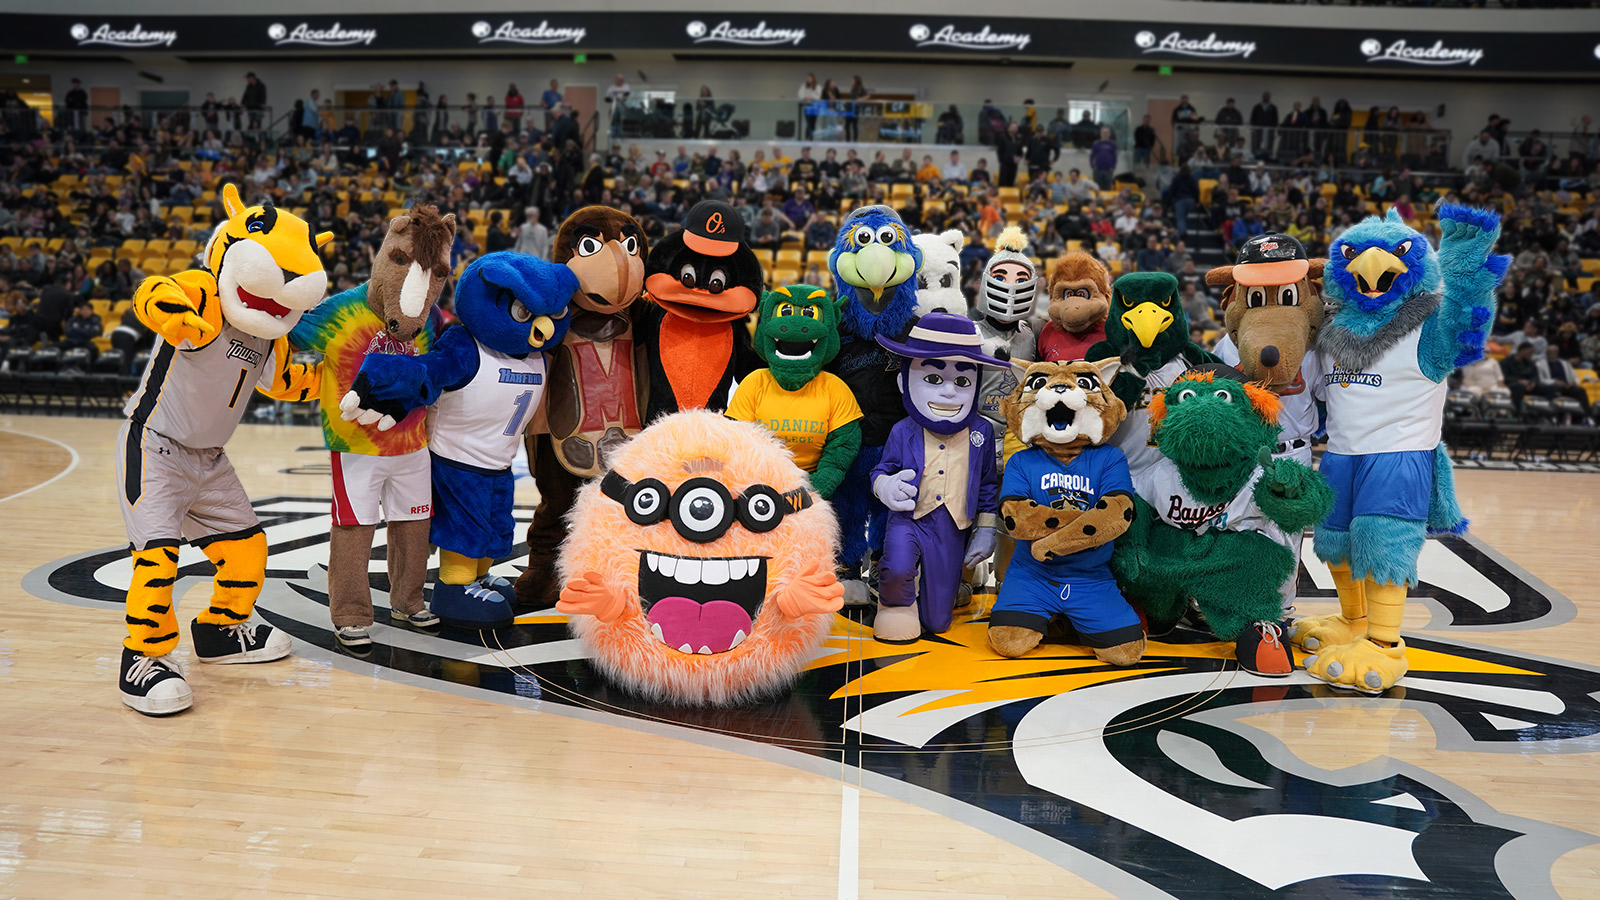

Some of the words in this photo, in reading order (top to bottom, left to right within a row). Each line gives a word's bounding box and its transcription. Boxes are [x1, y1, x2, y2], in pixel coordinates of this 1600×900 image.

[92, 23, 177, 46] Academy
[290, 22, 377, 45] Academy
[494, 20, 586, 44] Academy
[709, 20, 806, 45] Academy
[933, 24, 1031, 50] Academy
[1160, 31, 1256, 58] Academy
[1384, 39, 1483, 65] Academy
[228, 368, 248, 409] 1
[572, 339, 643, 434] M
[502, 389, 534, 437] 1
[1041, 472, 1095, 495] CARROLL
[410, 503, 430, 515] RFES
